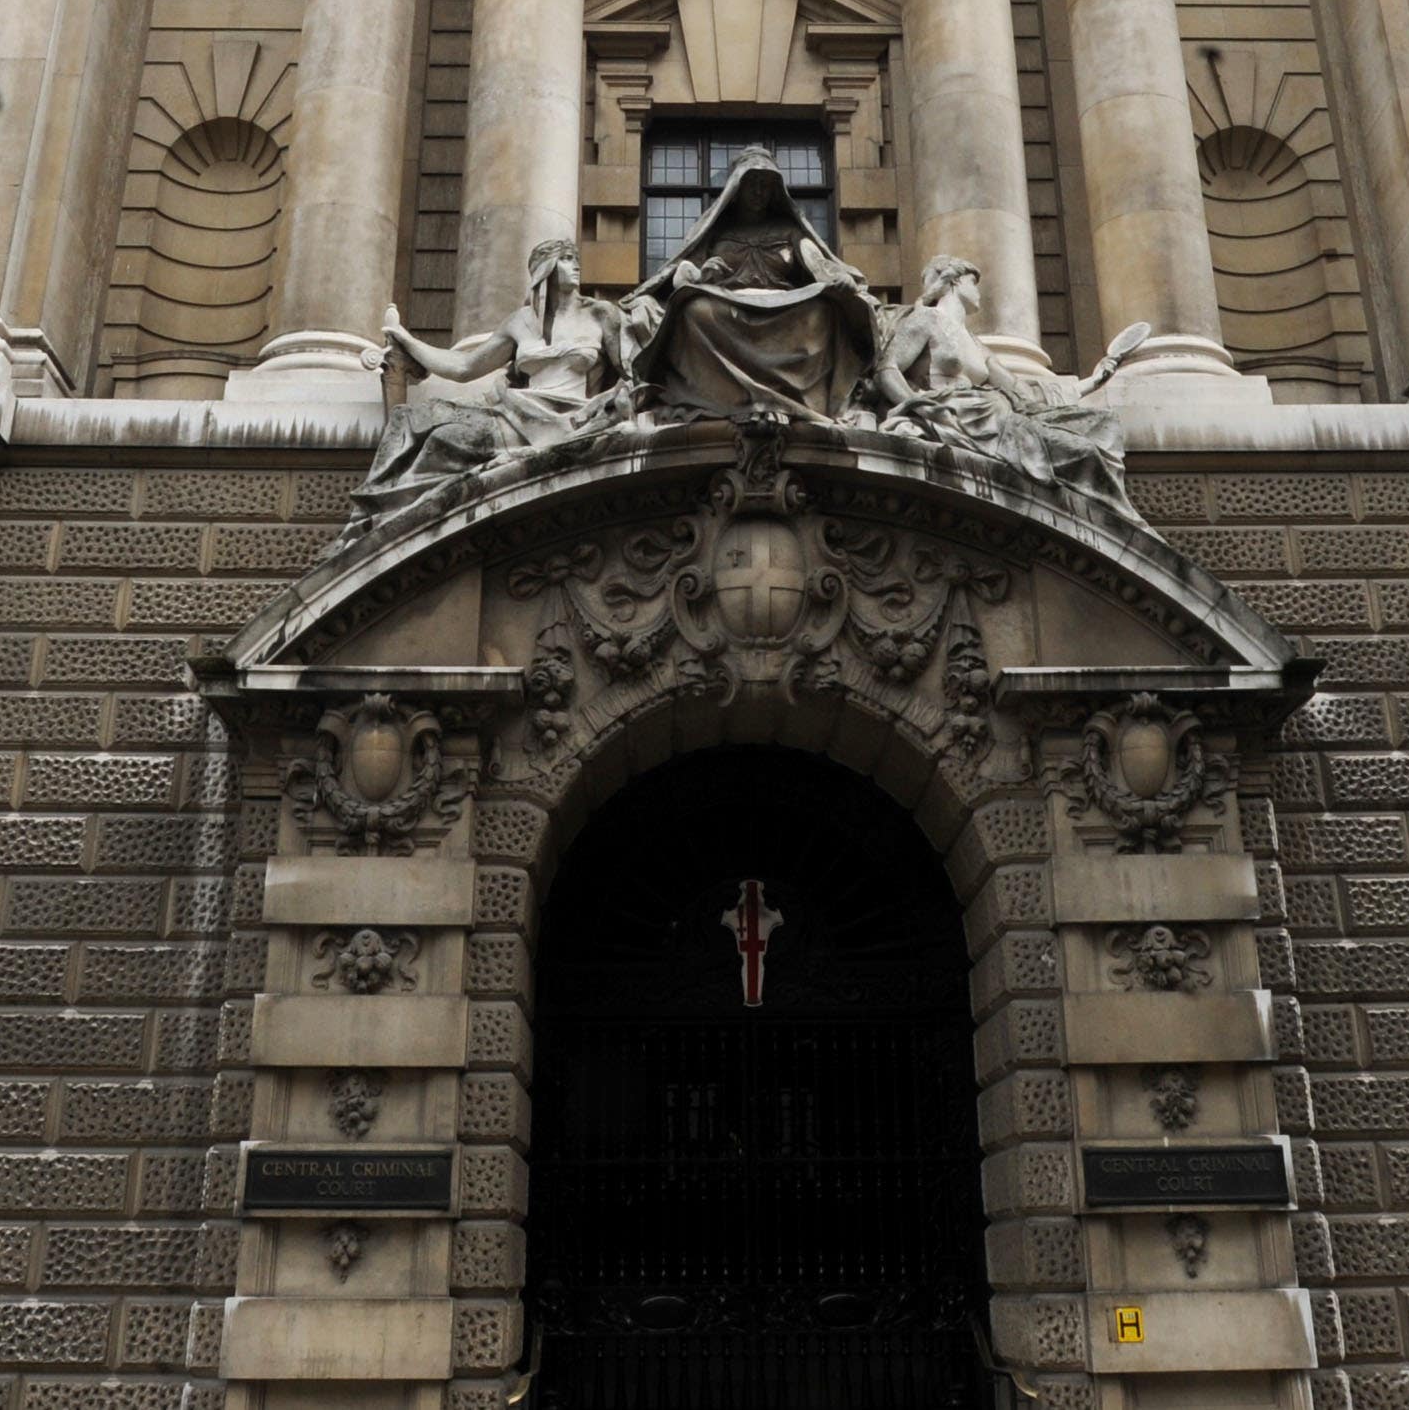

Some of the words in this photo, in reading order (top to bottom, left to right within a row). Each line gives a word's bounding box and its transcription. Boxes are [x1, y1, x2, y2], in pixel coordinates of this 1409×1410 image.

[262, 1161, 343, 1177] CENTRAL
[351, 1161, 437, 1177] CRIMINAL
[1101, 1157, 1181, 1173] CENTRAL
[1188, 1156, 1271, 1172] CRIMINAL
[317, 1180, 377, 1196] COURT
[1157, 1176, 1215, 1191] COURT
[1119, 1311, 1142, 1338] H
